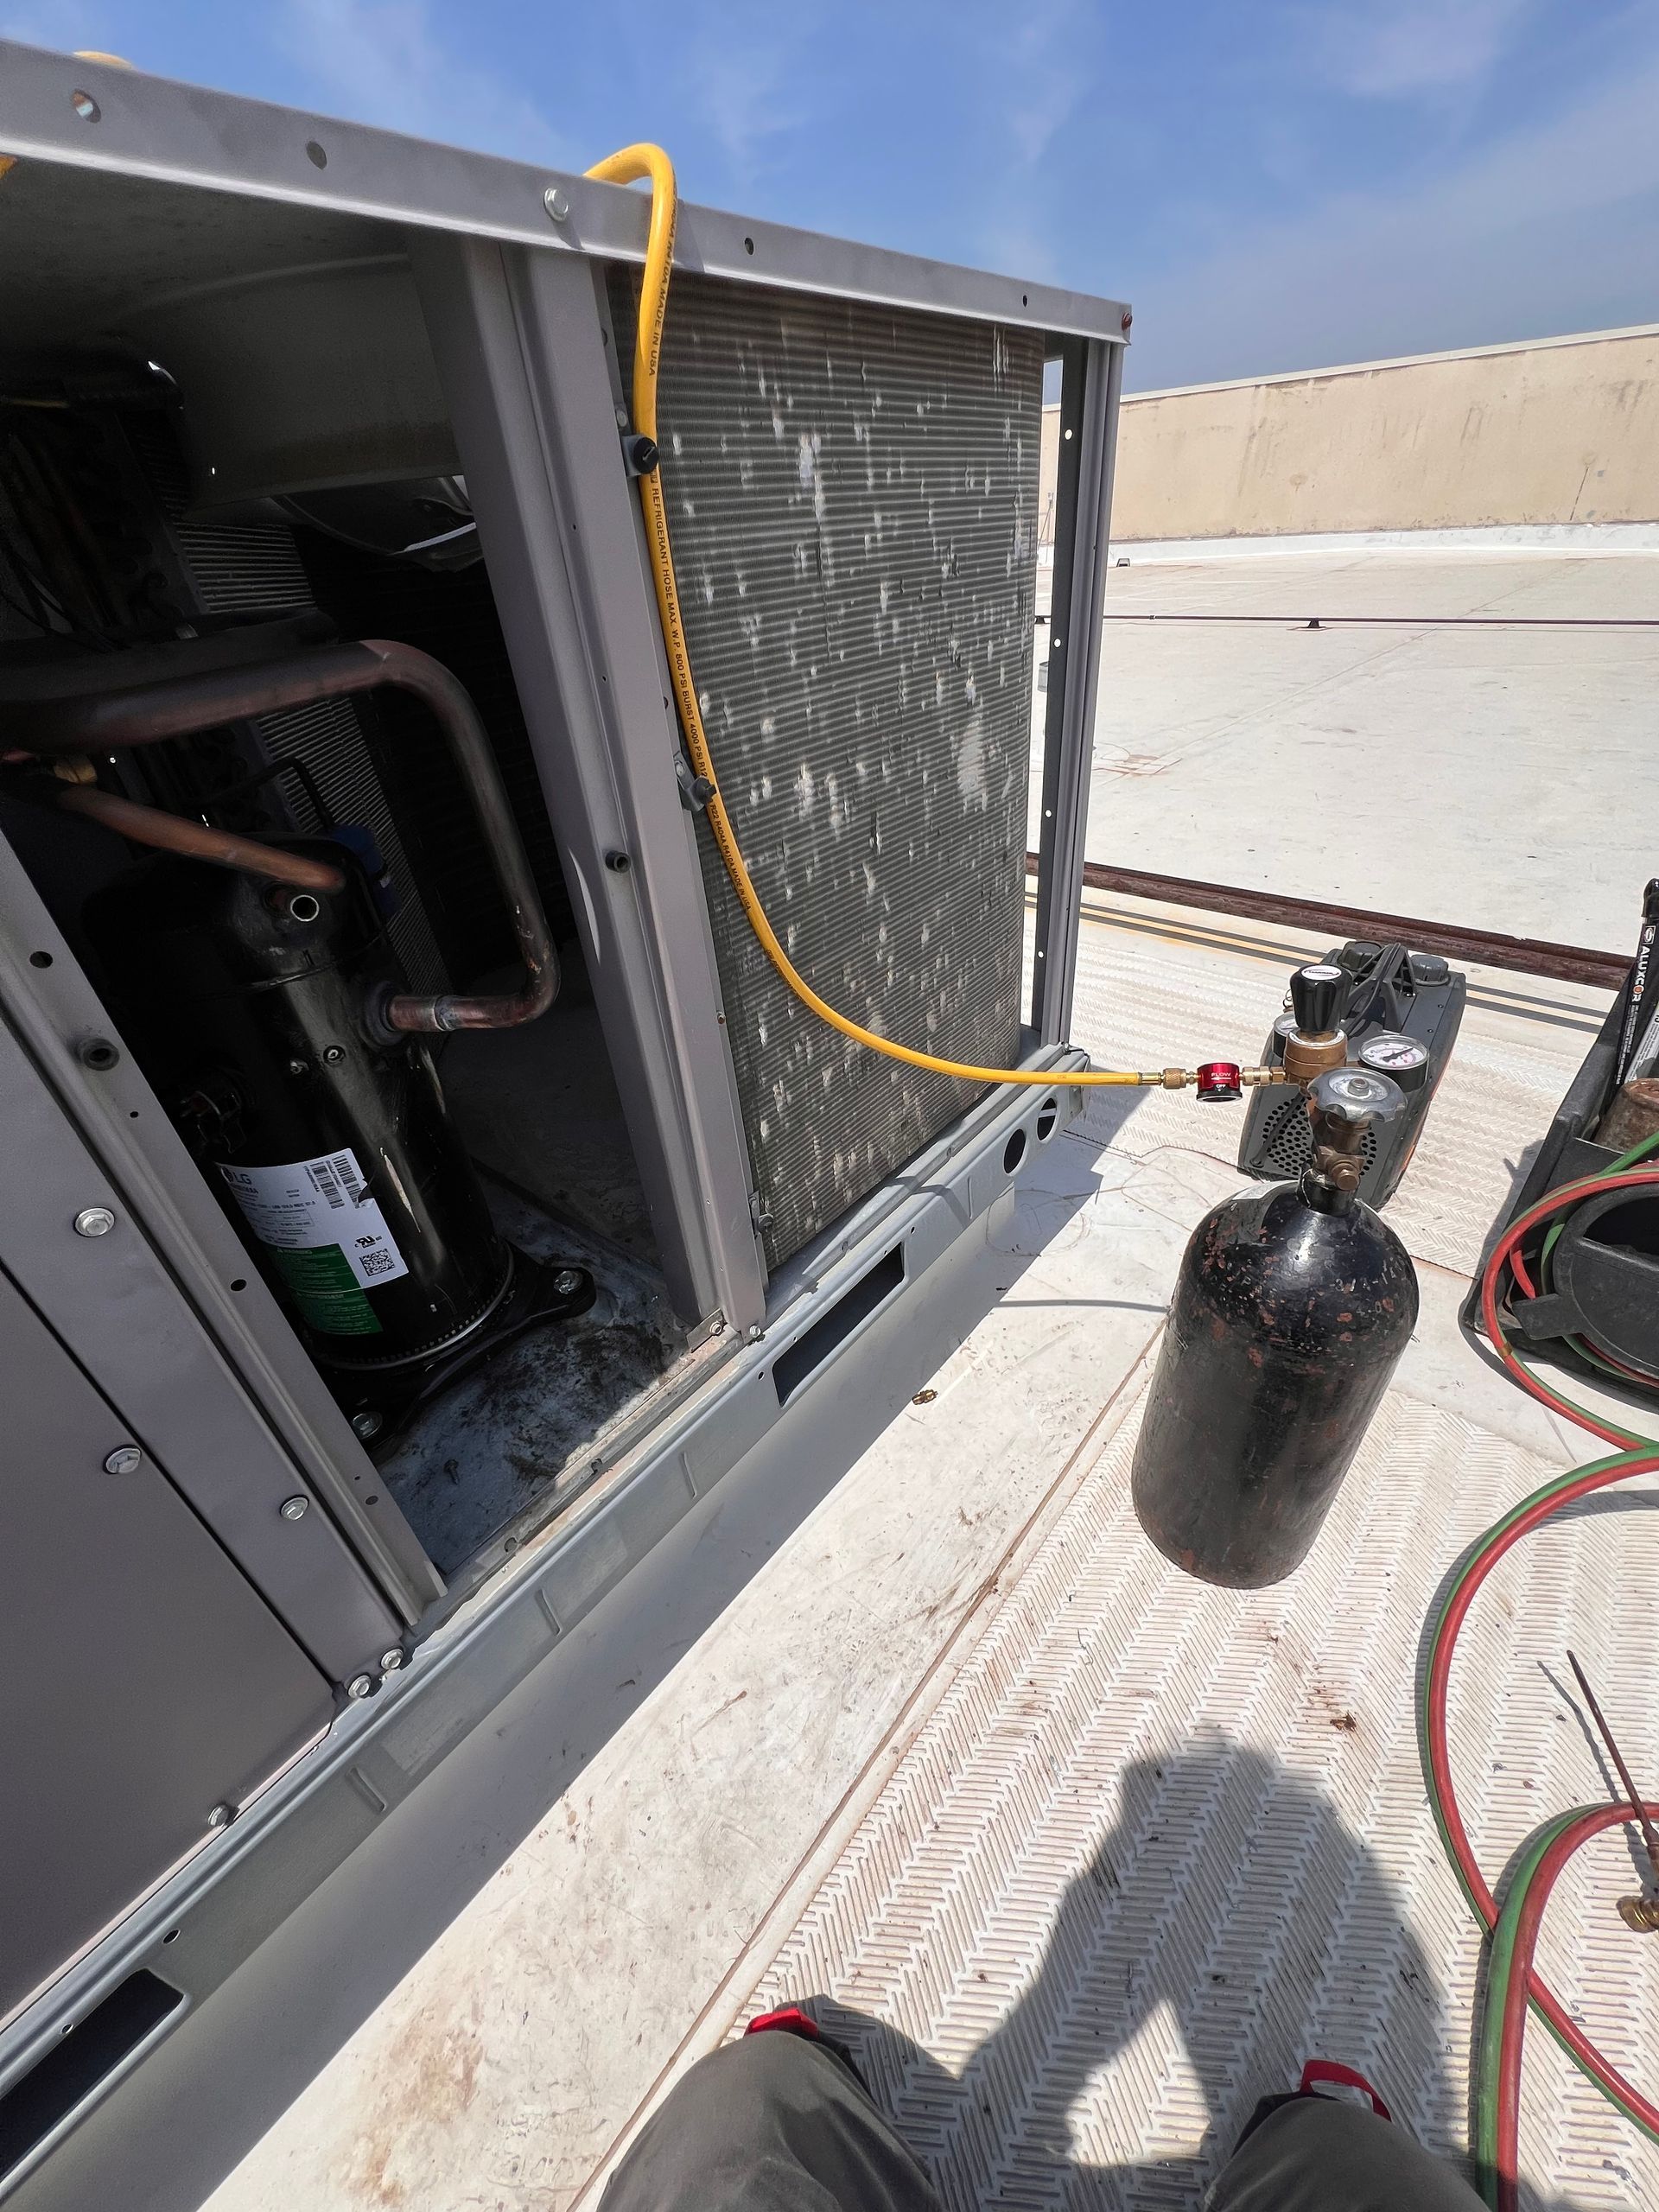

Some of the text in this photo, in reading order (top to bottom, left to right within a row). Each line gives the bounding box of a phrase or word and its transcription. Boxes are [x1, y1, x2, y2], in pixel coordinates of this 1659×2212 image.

[654, 289, 666, 327] MADE
[652, 332, 660, 346] IN
[648, 350, 658, 377] USA
[652, 488, 668, 565] REFRIGERANT
[662, 569, 674, 600] HOSE
[675, 653, 684, 671] 800
[678, 673, 688, 689] PSI
[682, 690, 695, 721] BURST
[689, 722, 700, 744] 4000
[695, 746, 703, 761] PSI
[709, 804, 719, 820] R22
[731, 868, 744, 889] MADE
[738, 887, 746, 898] IN
[741, 894, 752, 911] USA
[1632, 946, 1650, 1002] ALUXCOR
[233, 1172, 252, 1185] LG
